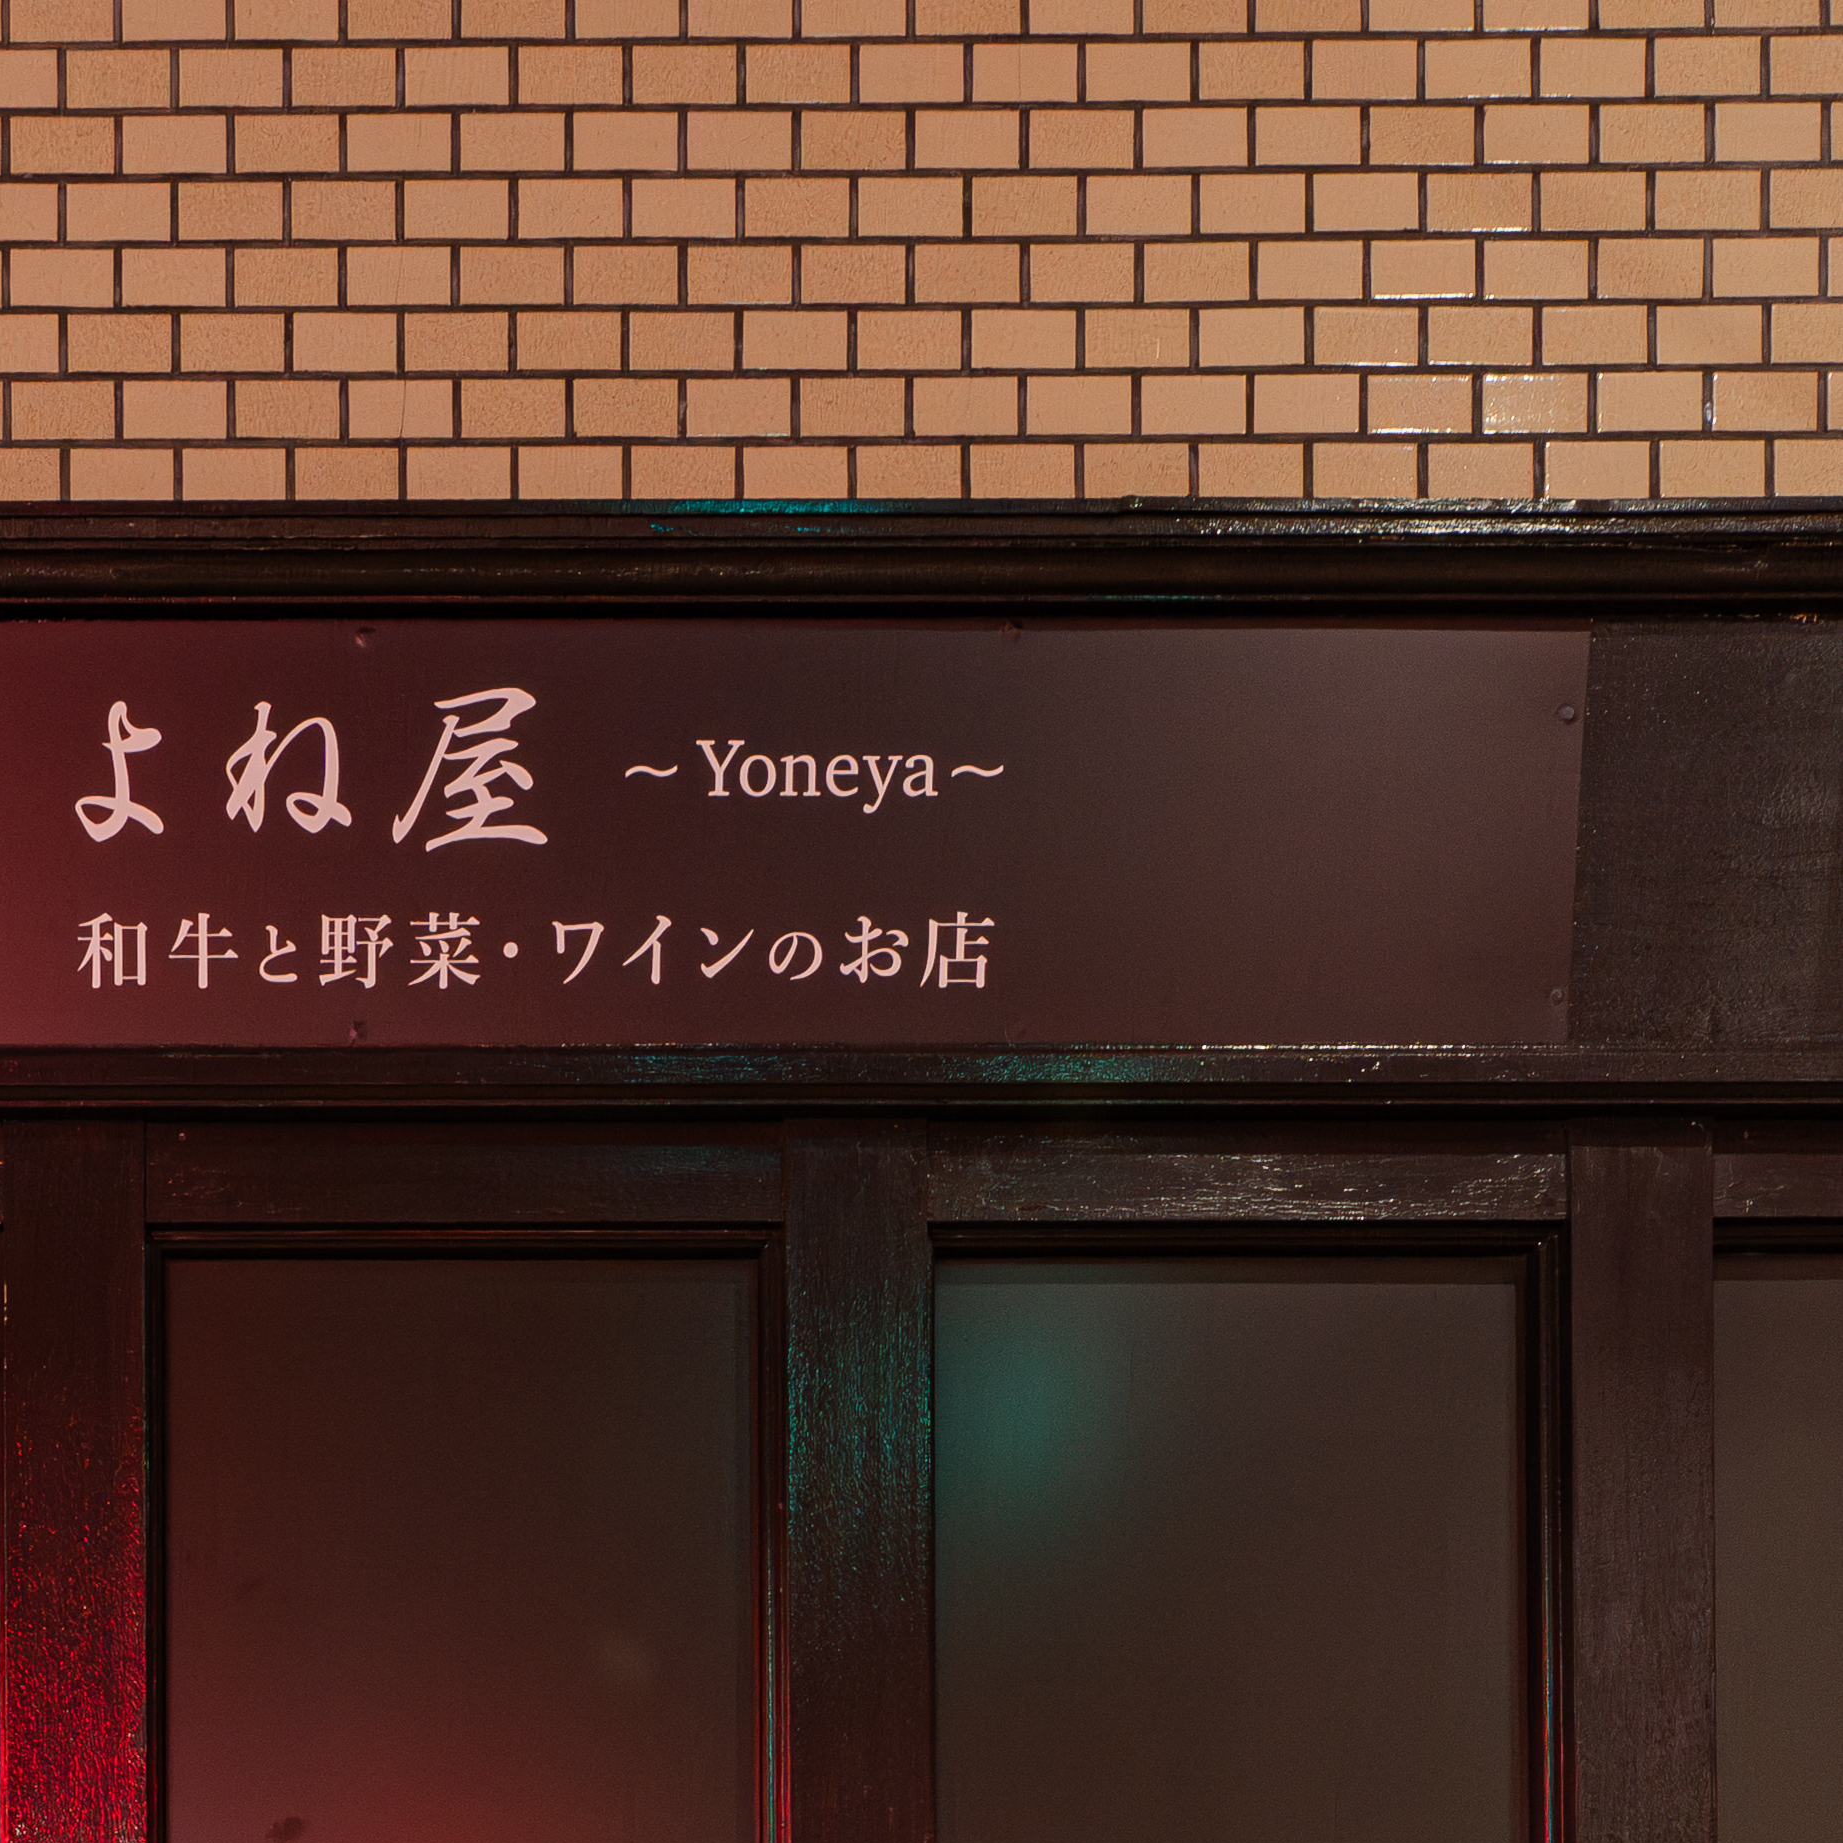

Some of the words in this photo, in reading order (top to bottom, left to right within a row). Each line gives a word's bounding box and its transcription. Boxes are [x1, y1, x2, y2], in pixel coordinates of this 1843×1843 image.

[74, 687, 548, 852] よね屋
[77, 911, 995, 990] 和牛と野菜・ワインのお店
